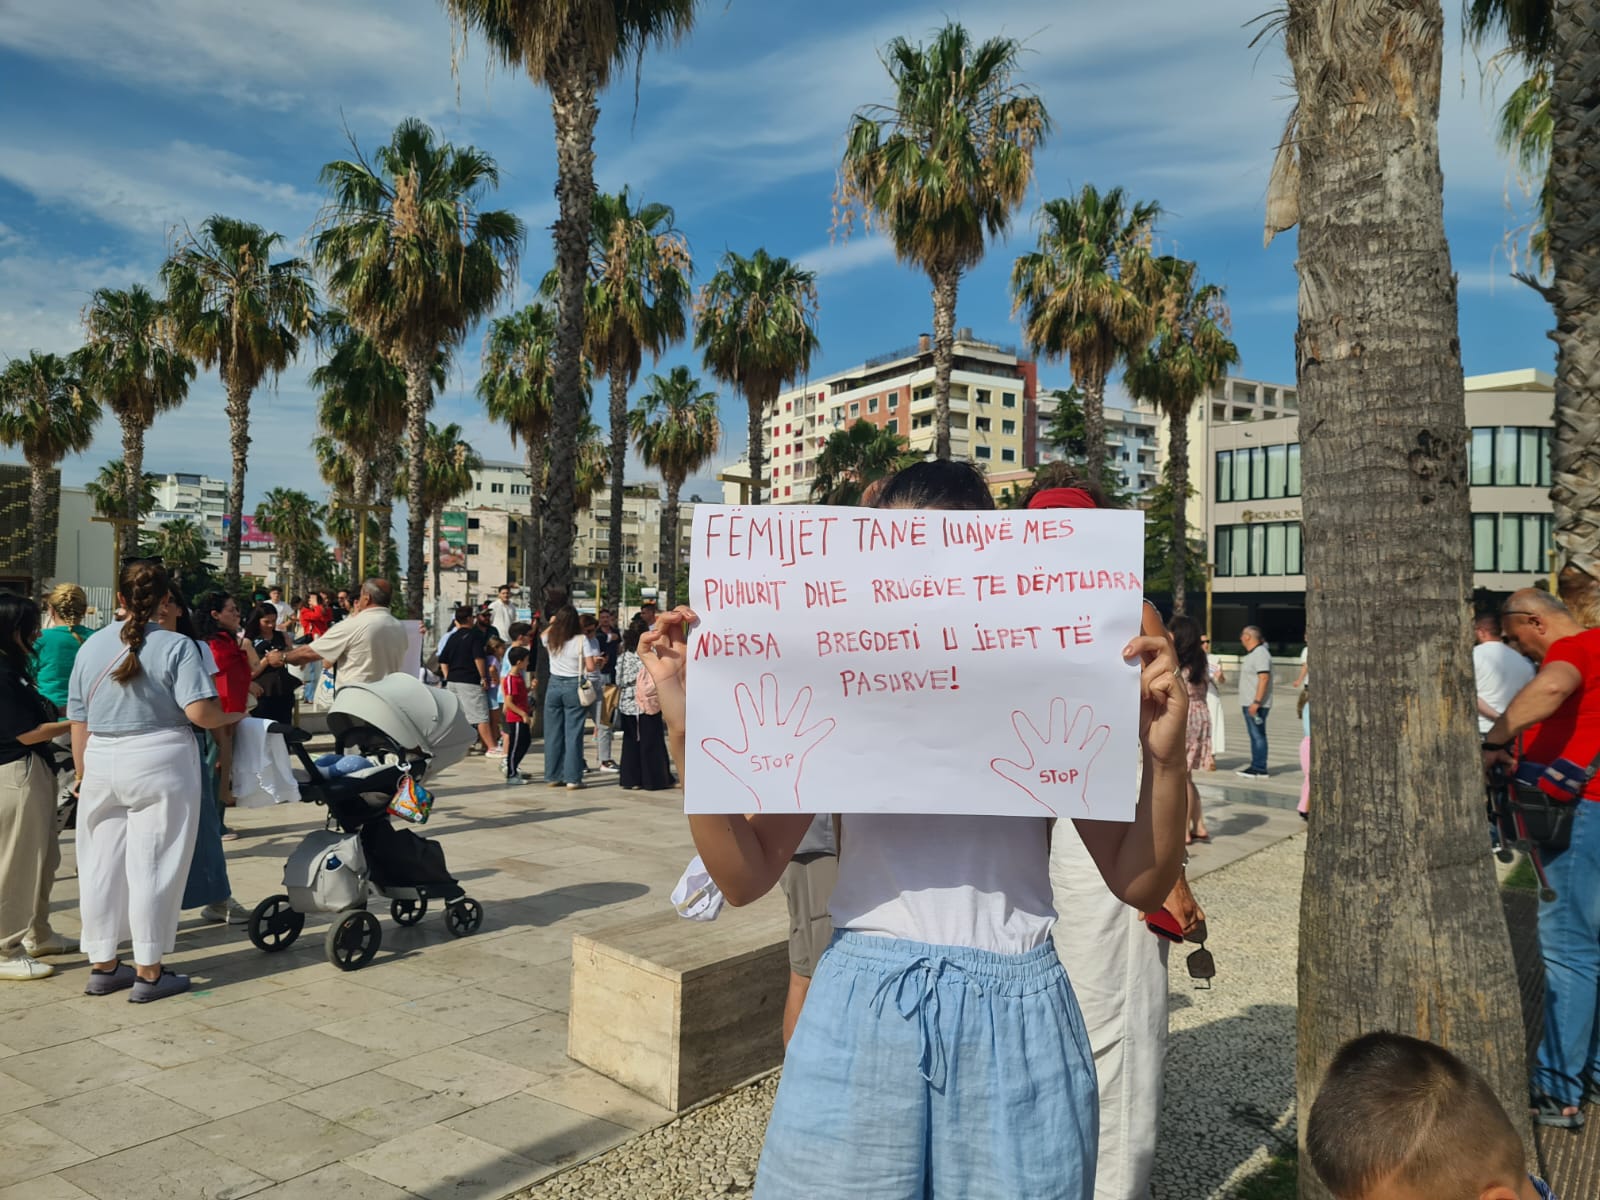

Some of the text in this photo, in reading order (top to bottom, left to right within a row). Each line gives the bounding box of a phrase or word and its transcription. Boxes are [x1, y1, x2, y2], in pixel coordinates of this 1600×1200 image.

[855, 516, 926, 553] TANË
[1023, 518, 1076, 545] MES
[804, 580, 848, 609] DHE
[871, 574, 966, 605] RRUGËVE
[972, 575, 1008, 603] TE
[1016, 566, 1142, 597] DËMTUARA
[693, 628, 781, 661] NDËRSA
[943, 626, 960, 652] U
[1052, 616, 1094, 651] TË
[839, 665, 961, 698] PASURVE!
[750, 753, 794, 772] STOP
[1039, 767, 1079, 785] STOP
